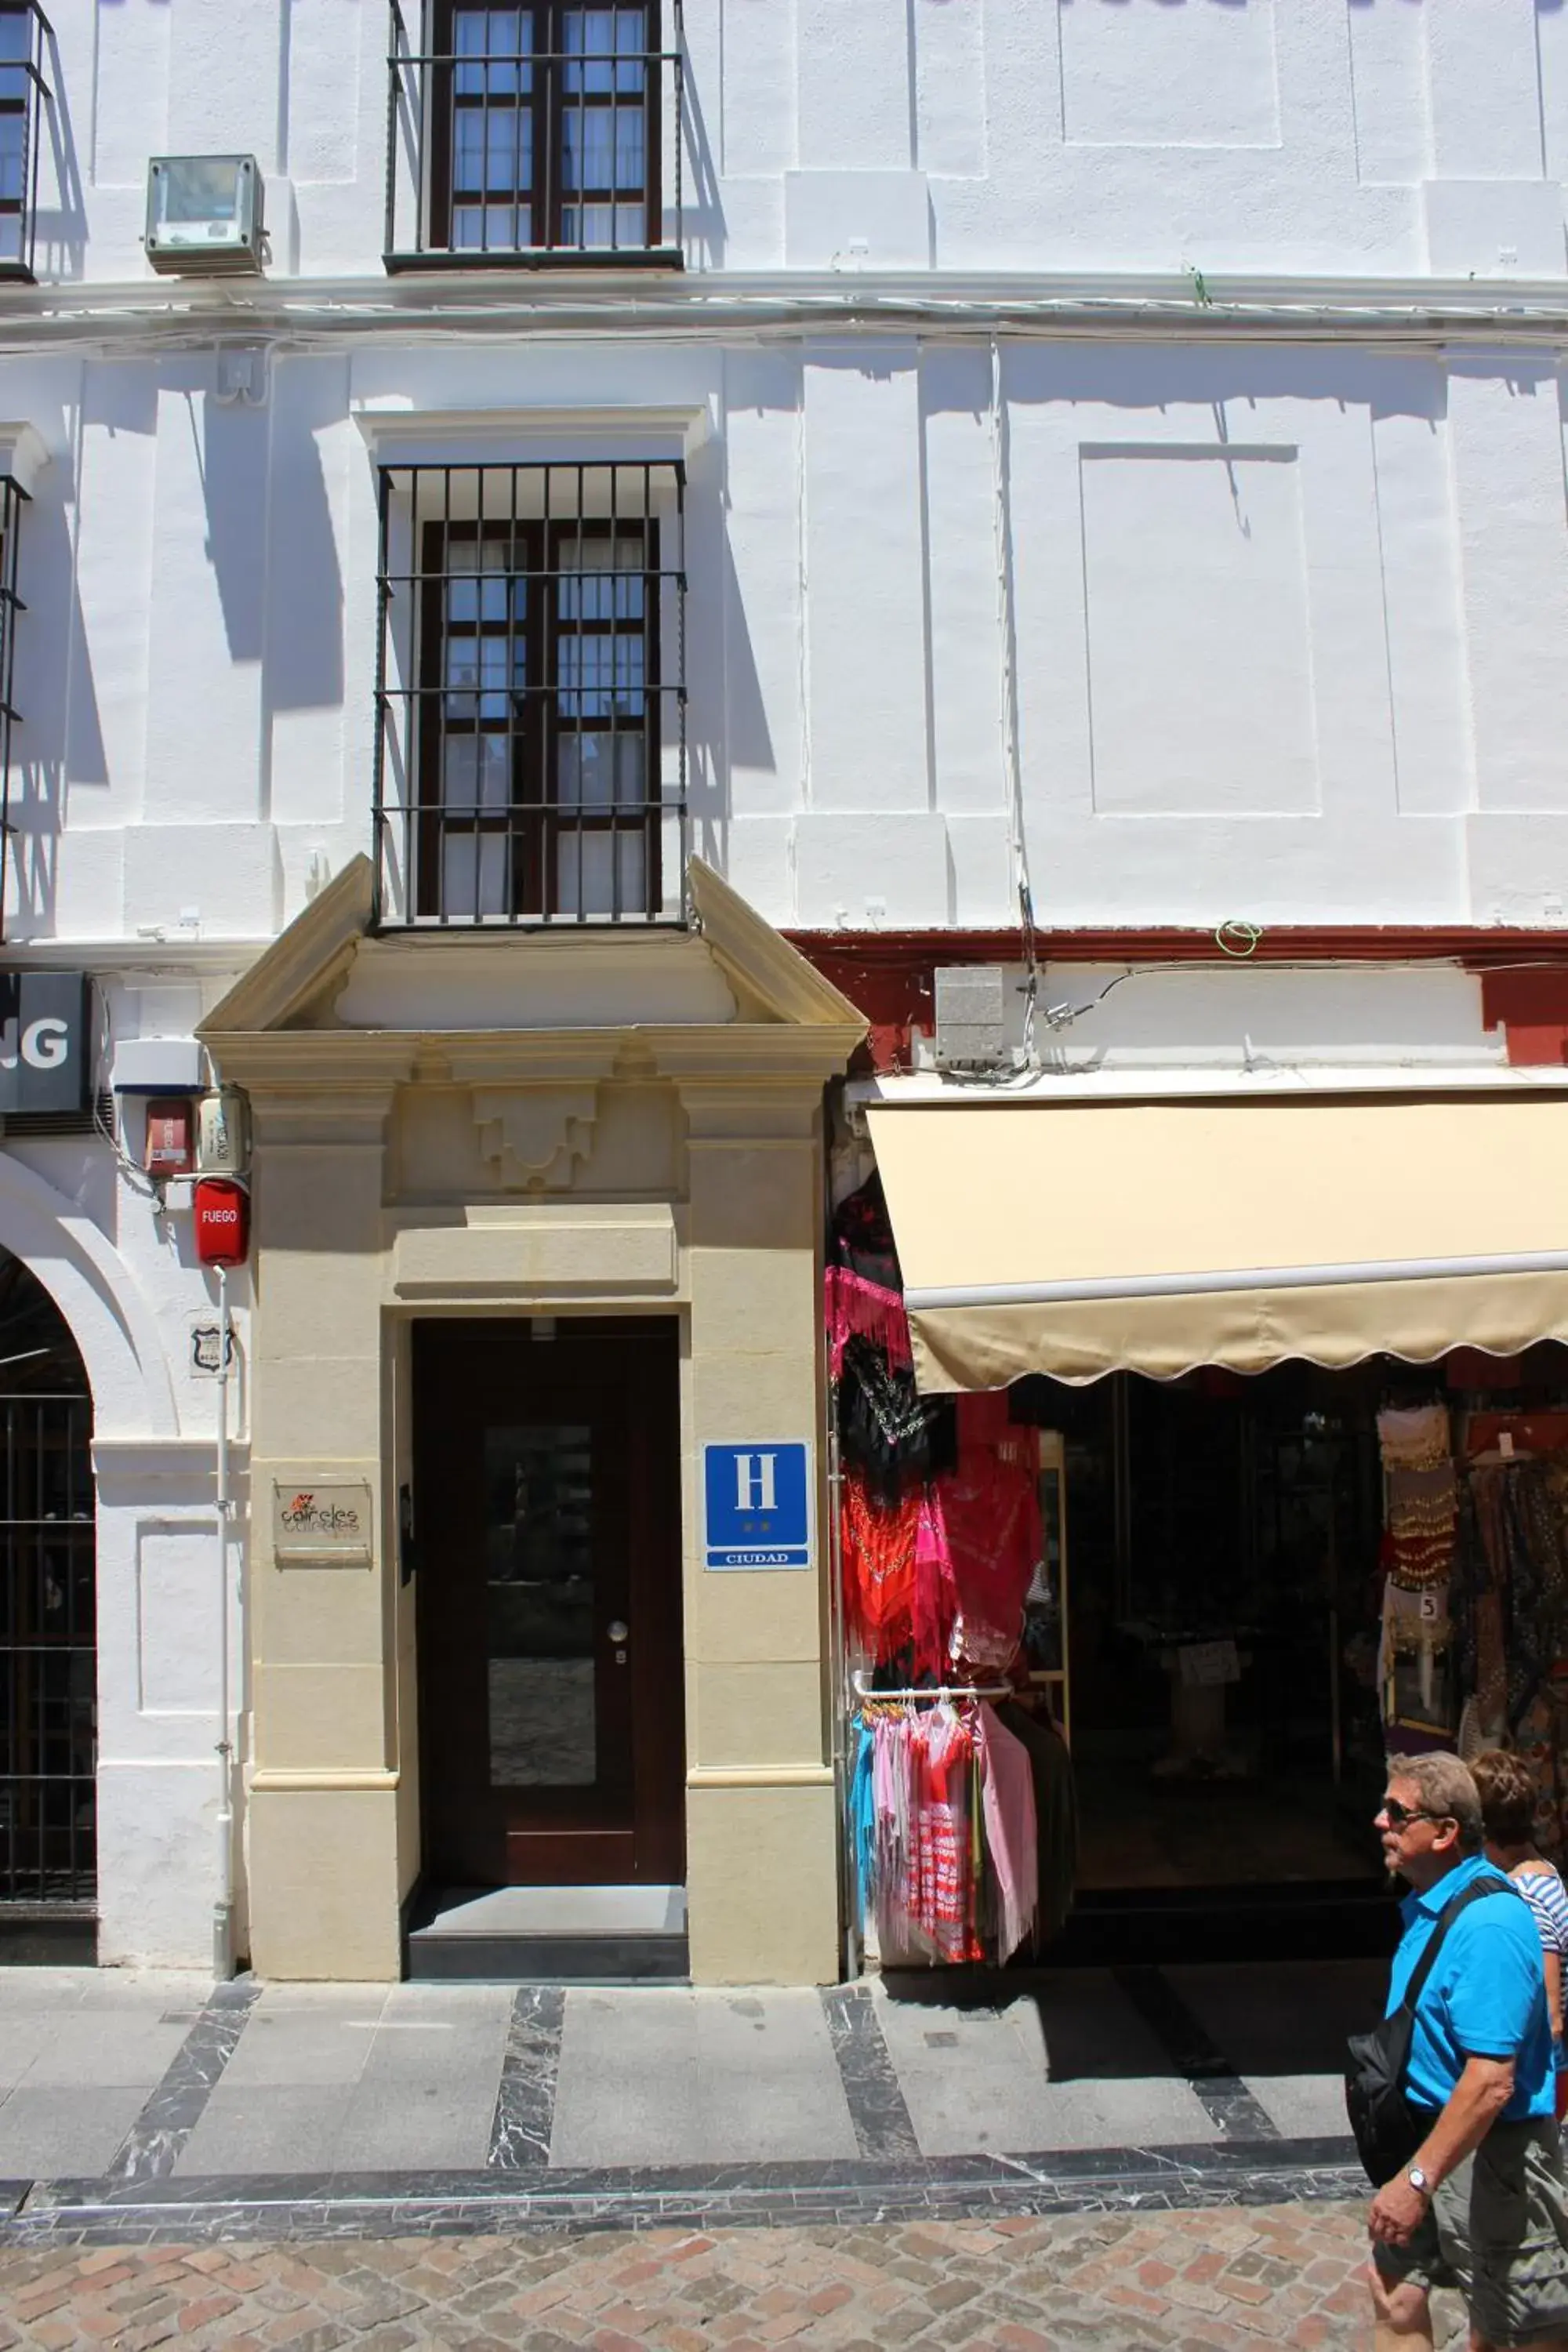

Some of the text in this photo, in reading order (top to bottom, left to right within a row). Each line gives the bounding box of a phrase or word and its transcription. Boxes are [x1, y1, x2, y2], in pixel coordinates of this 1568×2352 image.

[202, 1210, 238, 1222] FUEGO
[733, 1454, 779, 1510] H
[725, 1552, 789, 1564] CIUDAD
[1423, 1599, 1434, 1616] 5
